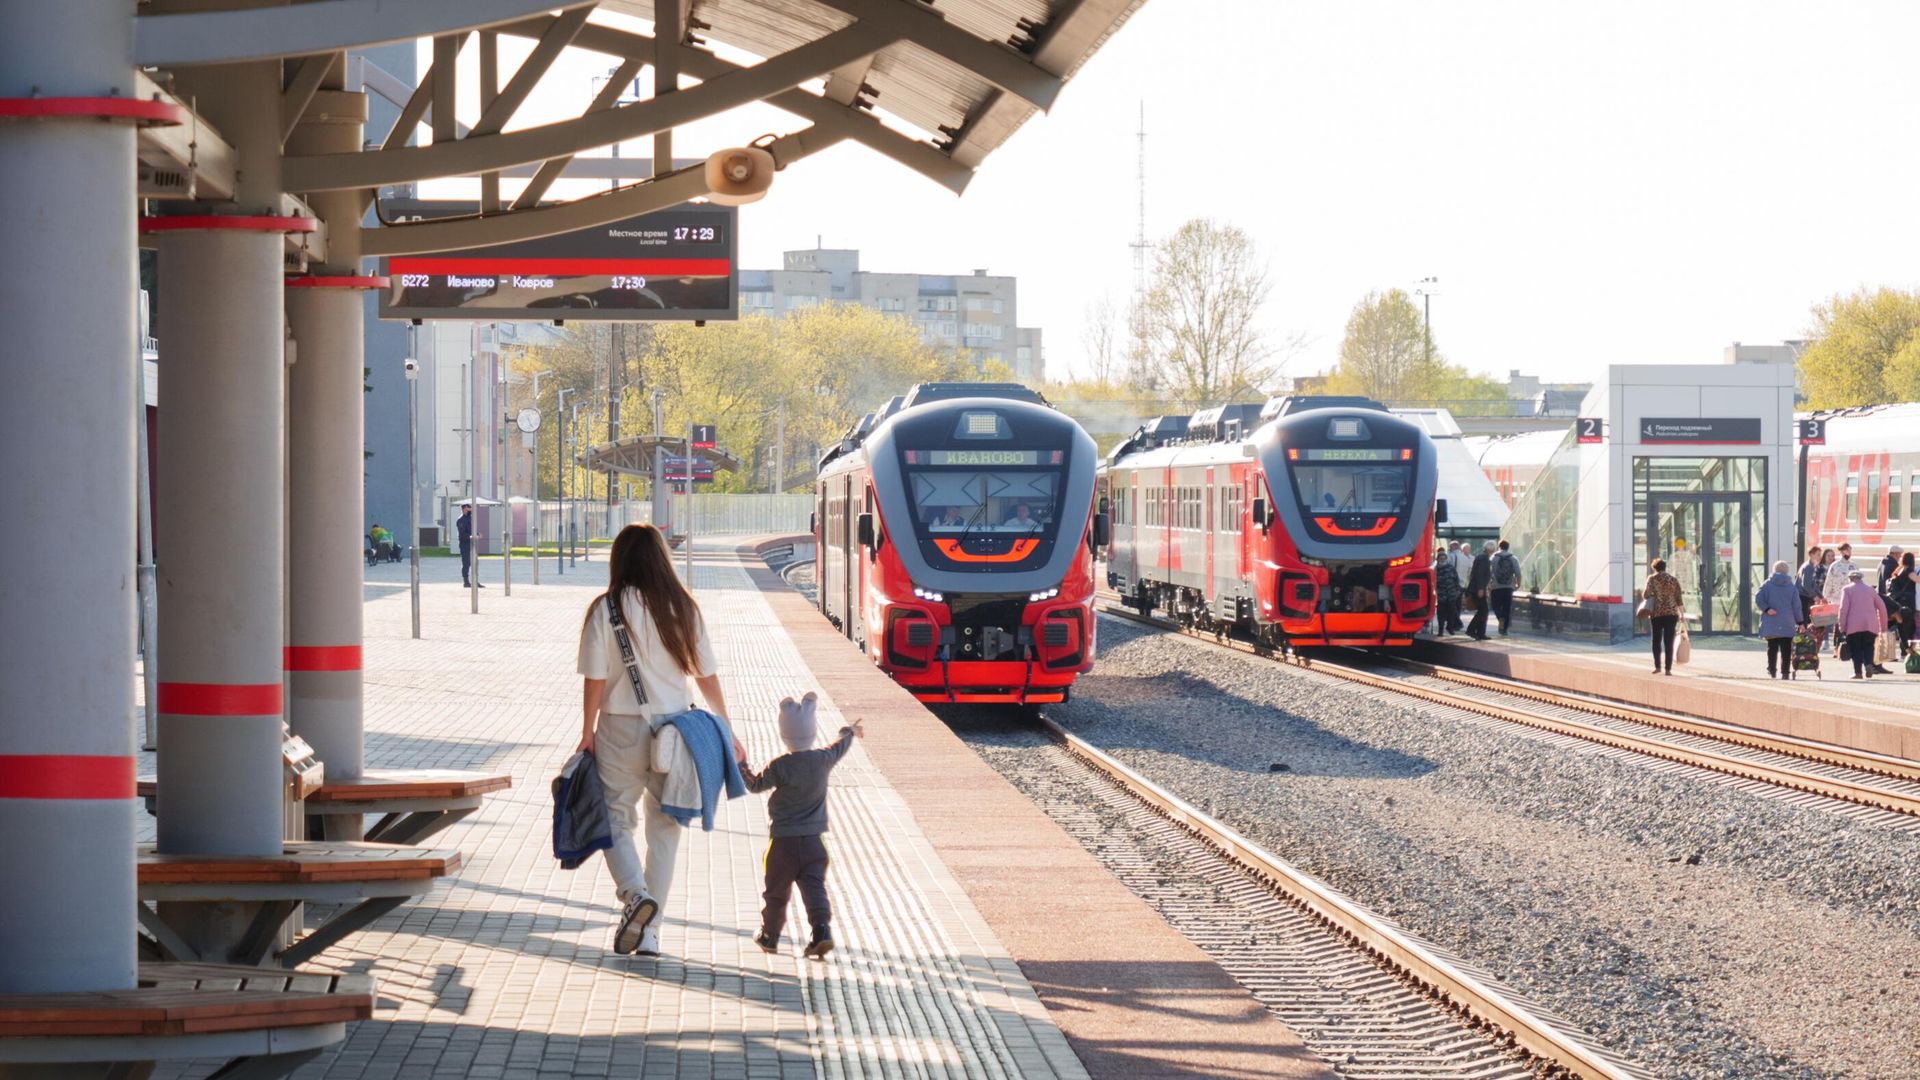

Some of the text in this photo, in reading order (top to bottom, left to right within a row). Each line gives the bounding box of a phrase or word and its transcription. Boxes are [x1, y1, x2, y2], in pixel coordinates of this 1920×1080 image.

[608, 230, 668, 240] Местное время
[674, 227, 715, 241] 17:29
[401, 275, 430, 288] 6272
[447, 276, 496, 288] Иваново
[513, 276, 554, 289] Ковров
[611, 276, 646, 289] 17:30
[700, 426, 707, 442] 1
[1584, 419, 1596, 436] 2
[1655, 424, 1713, 432] Переход подземный
[1807, 420, 1819, 438] 3
